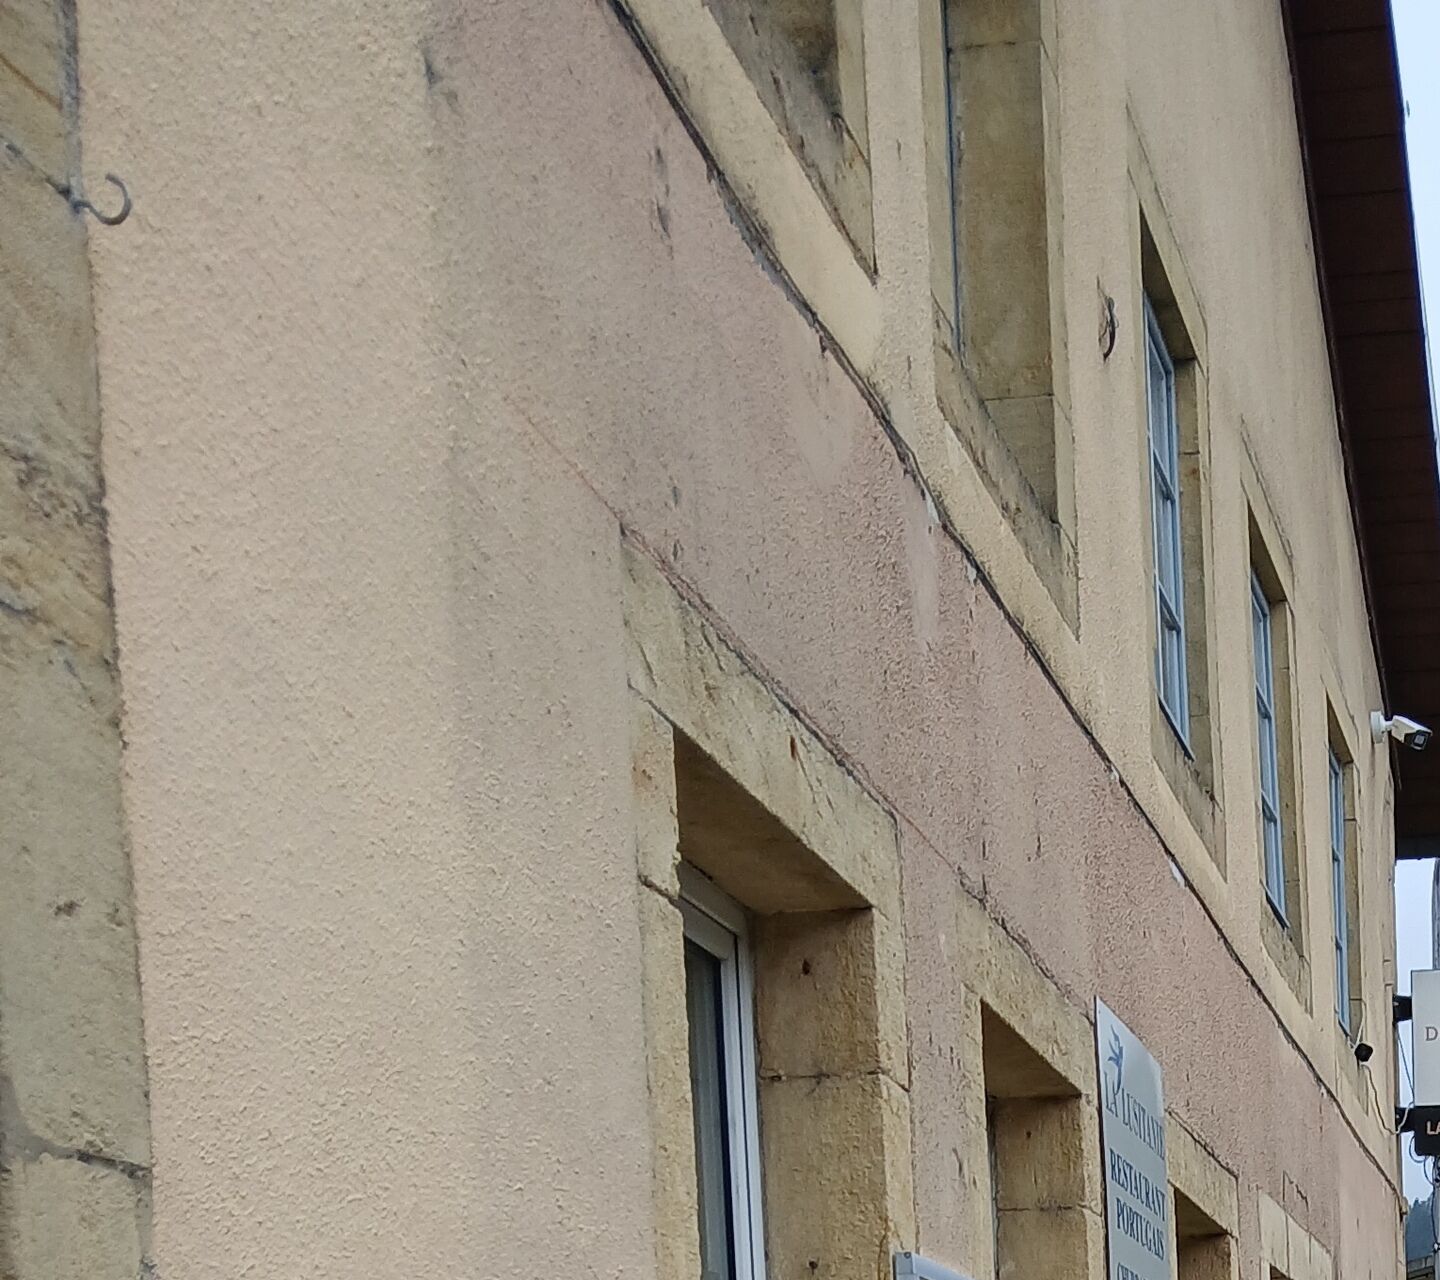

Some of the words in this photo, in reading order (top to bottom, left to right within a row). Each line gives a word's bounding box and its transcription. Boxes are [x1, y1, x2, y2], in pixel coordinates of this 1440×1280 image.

[1104, 1070, 1118, 1118] LA
[1122, 1087, 1165, 1160] LUSITANIE
[1109, 1147, 1166, 1222] RESTAURANT
[1115, 1197, 1165, 1261] PORTUGAIS
